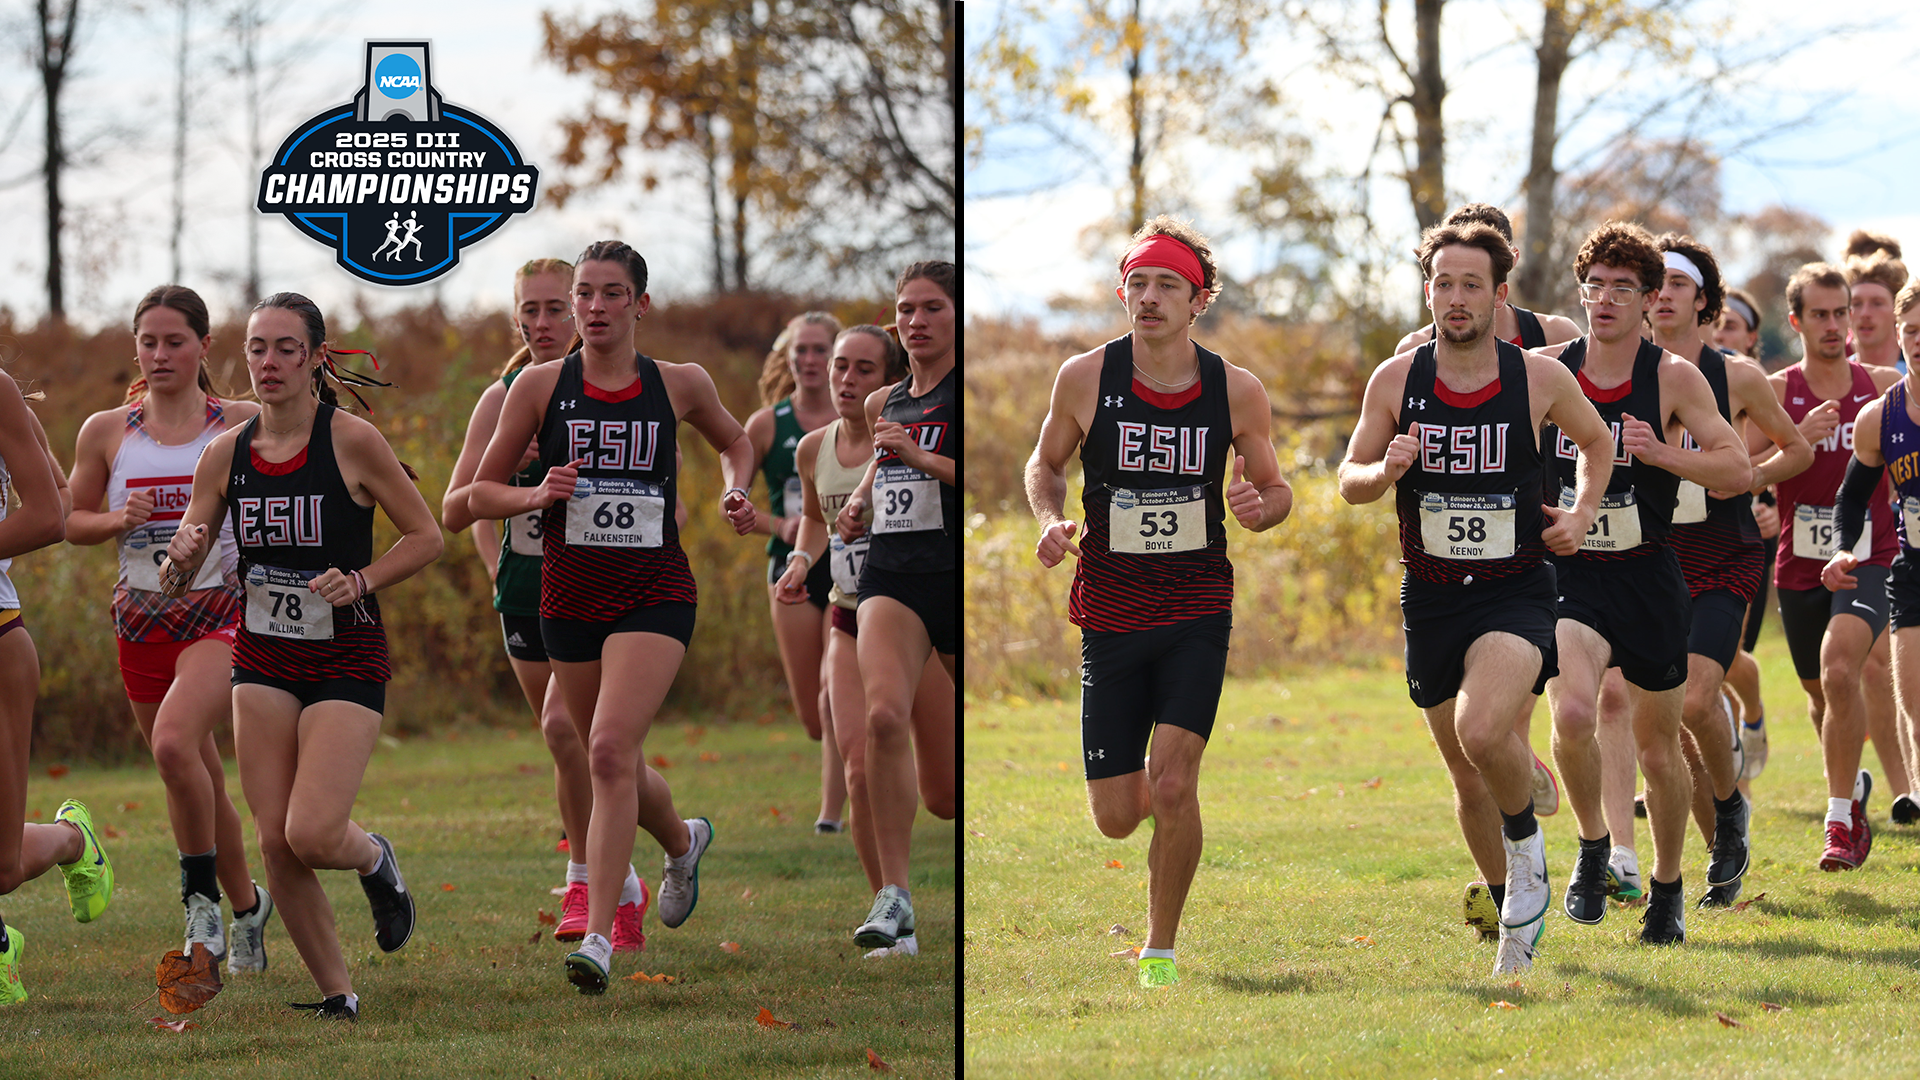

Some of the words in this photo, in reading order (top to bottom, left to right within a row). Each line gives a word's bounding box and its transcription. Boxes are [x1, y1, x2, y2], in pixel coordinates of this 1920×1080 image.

[565, 419, 661, 471] ESU
[1116, 421, 1210, 475] ESU
[1418, 423, 1511, 474] ESU
[1889, 451, 1919, 487] WEST
[885, 488, 914, 516] 39
[1175, 495, 1189, 503] 2025
[237, 494, 324, 547] ESU
[593, 502, 634, 529] 68
[885, 519, 913, 529] PEROZZI
[1139, 510, 1179, 537] 53
[584, 531, 643, 543] FALKENSTEIN
[1447, 516, 1487, 543] 58
[1145, 540, 1173, 550] BOYLE
[1450, 545, 1484, 556] KEENOY
[1582, 539, 1617, 548] ATESURE
[297, 579, 308, 587] 202
[268, 590, 303, 621] 78
[269, 620, 305, 636] WILLIAMS
